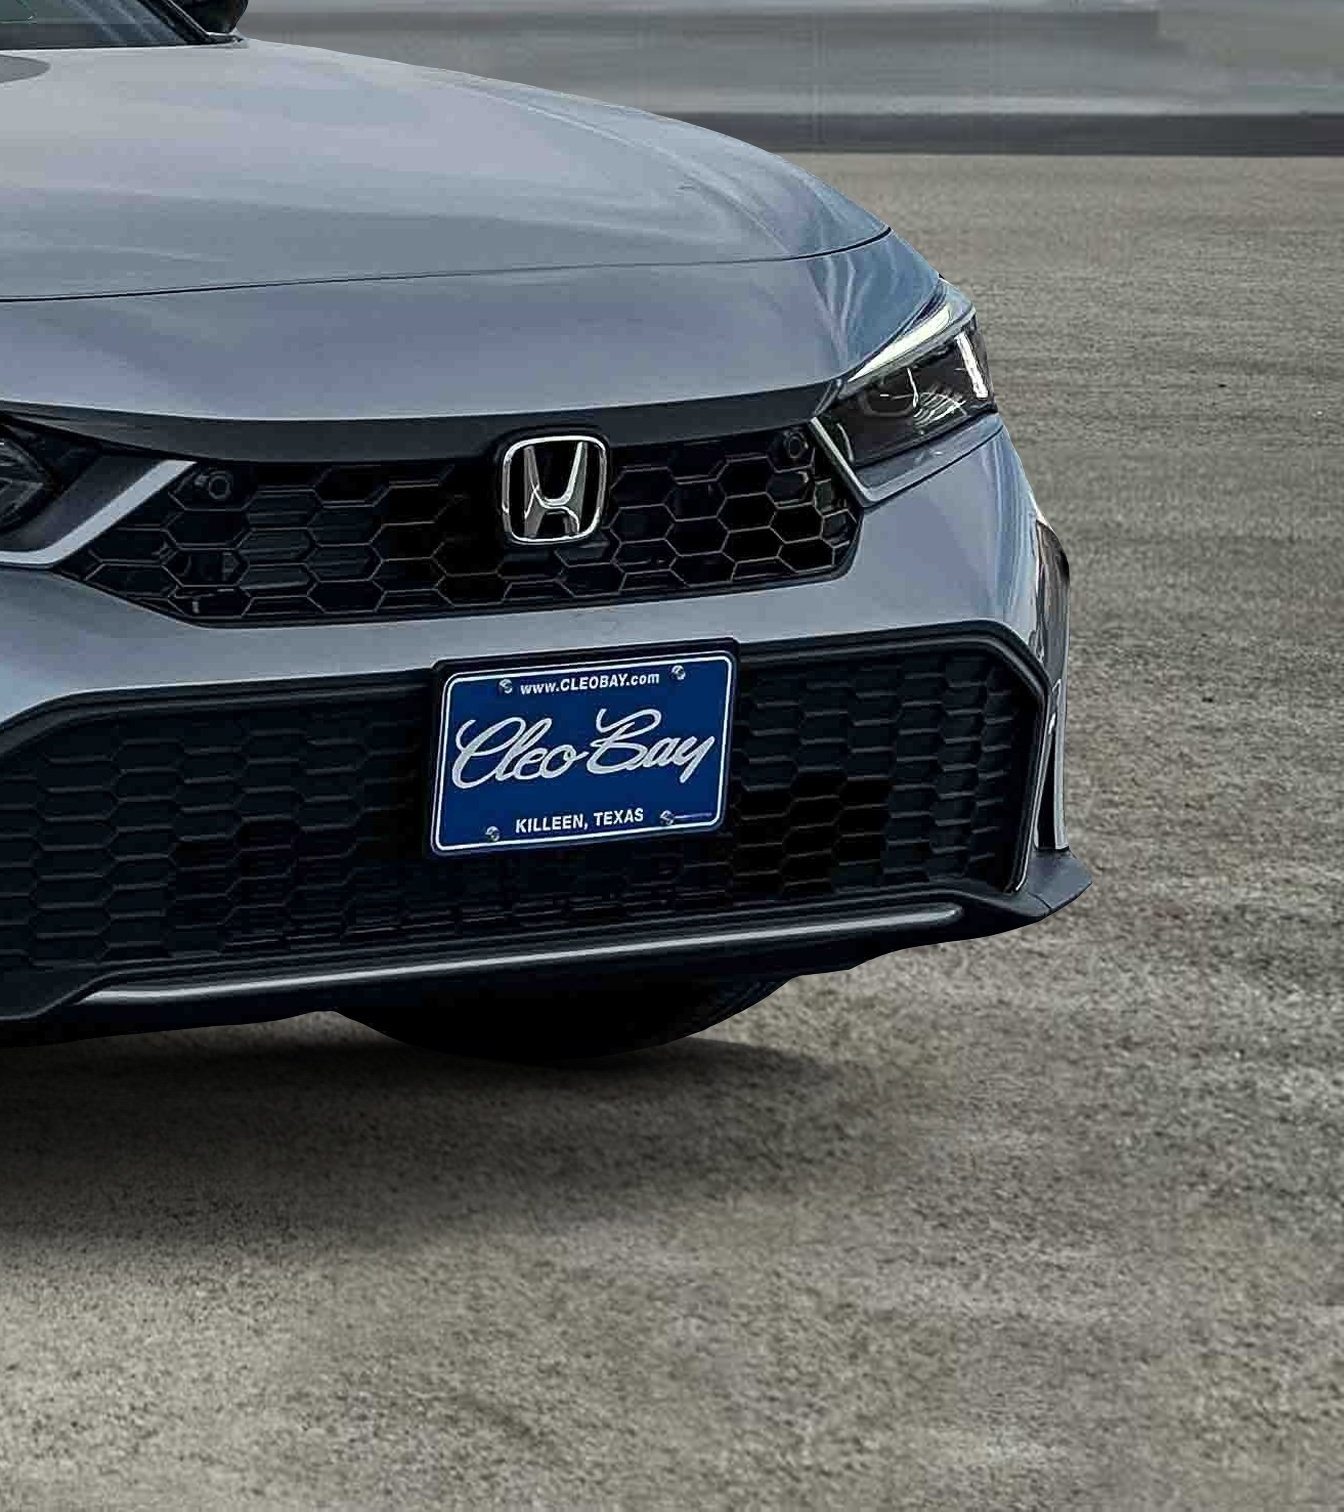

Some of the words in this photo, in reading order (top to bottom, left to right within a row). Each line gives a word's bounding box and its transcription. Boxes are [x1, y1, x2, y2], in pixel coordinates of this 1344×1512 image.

[520, 672, 660, 695] www.CLEOBAY.com
[452, 716, 589, 789] Cleo
[585, 708, 715, 784] Bay
[515, 813, 589, 834] KILLEEN,
[594, 807, 644, 827] TEXAS
